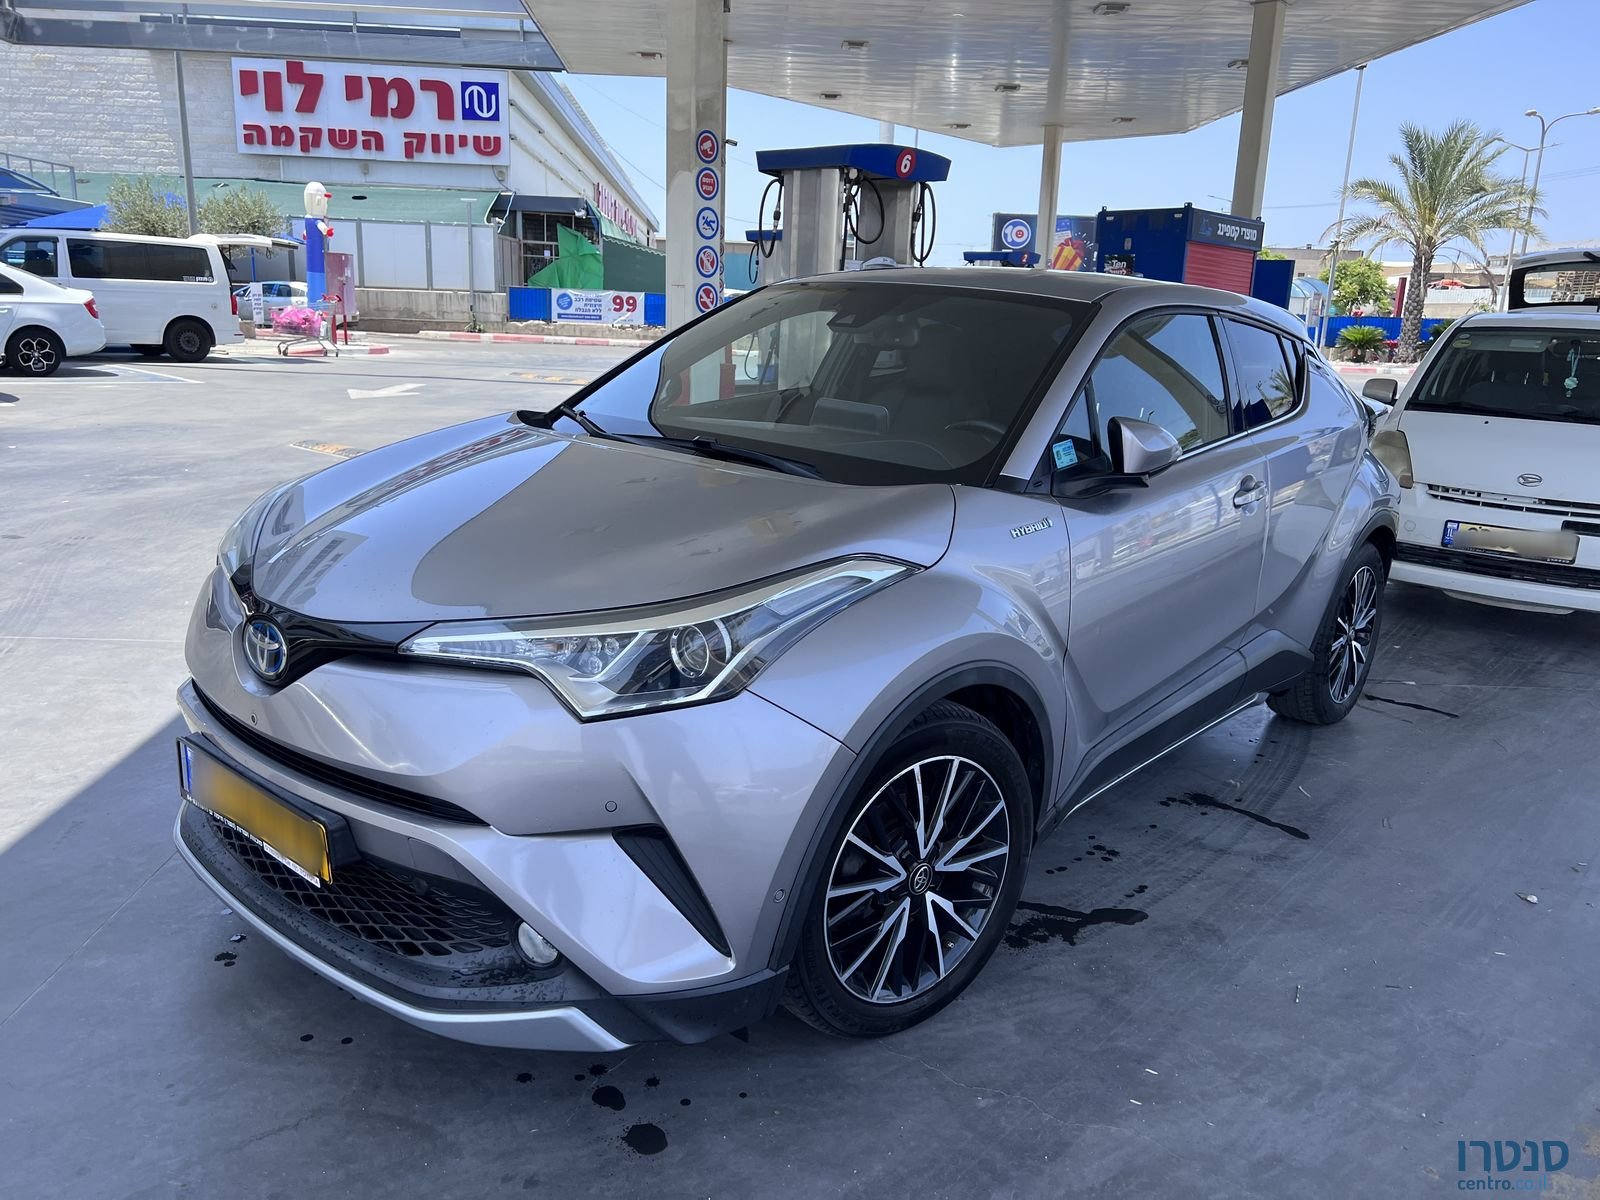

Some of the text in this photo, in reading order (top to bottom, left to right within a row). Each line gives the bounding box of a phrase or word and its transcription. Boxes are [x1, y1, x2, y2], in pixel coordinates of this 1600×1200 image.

[239, 60, 455, 121] רמי לוי
[242, 124, 501, 159] שיווק השקמה
[901, 154, 912, 173] 6
[1217, 223, 1257, 241] מוצרי קמפינג
[1111, 260, 1127, 268] Ten
[612, 295, 638, 313] 99
[1010, 518, 1053, 539] HYBRID
